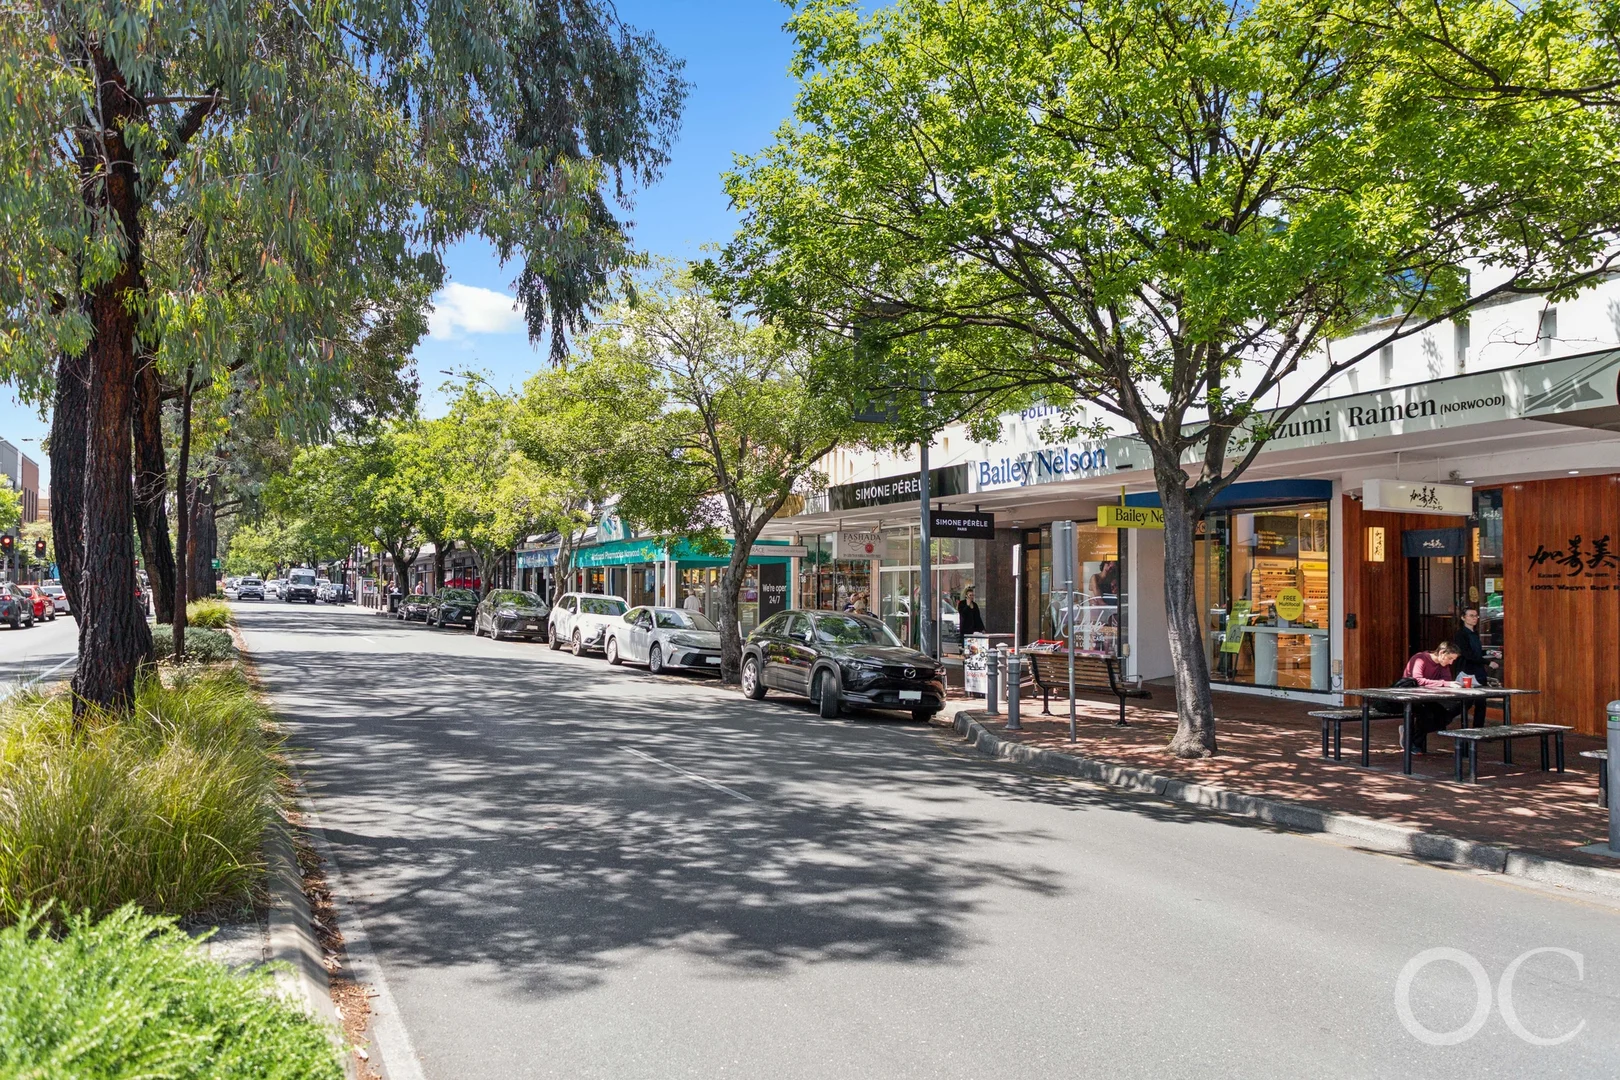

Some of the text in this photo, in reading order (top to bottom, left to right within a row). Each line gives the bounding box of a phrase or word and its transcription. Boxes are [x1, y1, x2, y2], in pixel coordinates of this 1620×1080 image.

[1252, 395, 1506, 443] zumi Ramen (NORWOOD)
[979, 448, 1107, 487] Bailey Nelson
[855, 477, 931, 501] SIMONE PÉRÈL
[935, 518, 988, 528] SIMONE PÉRÈLE
[1115, 508, 1164, 525] Bailey Ne
[843, 533, 882, 542] FASHADA
[762, 583, 787, 595] We're open
[768, 595, 781, 604] 24/7
